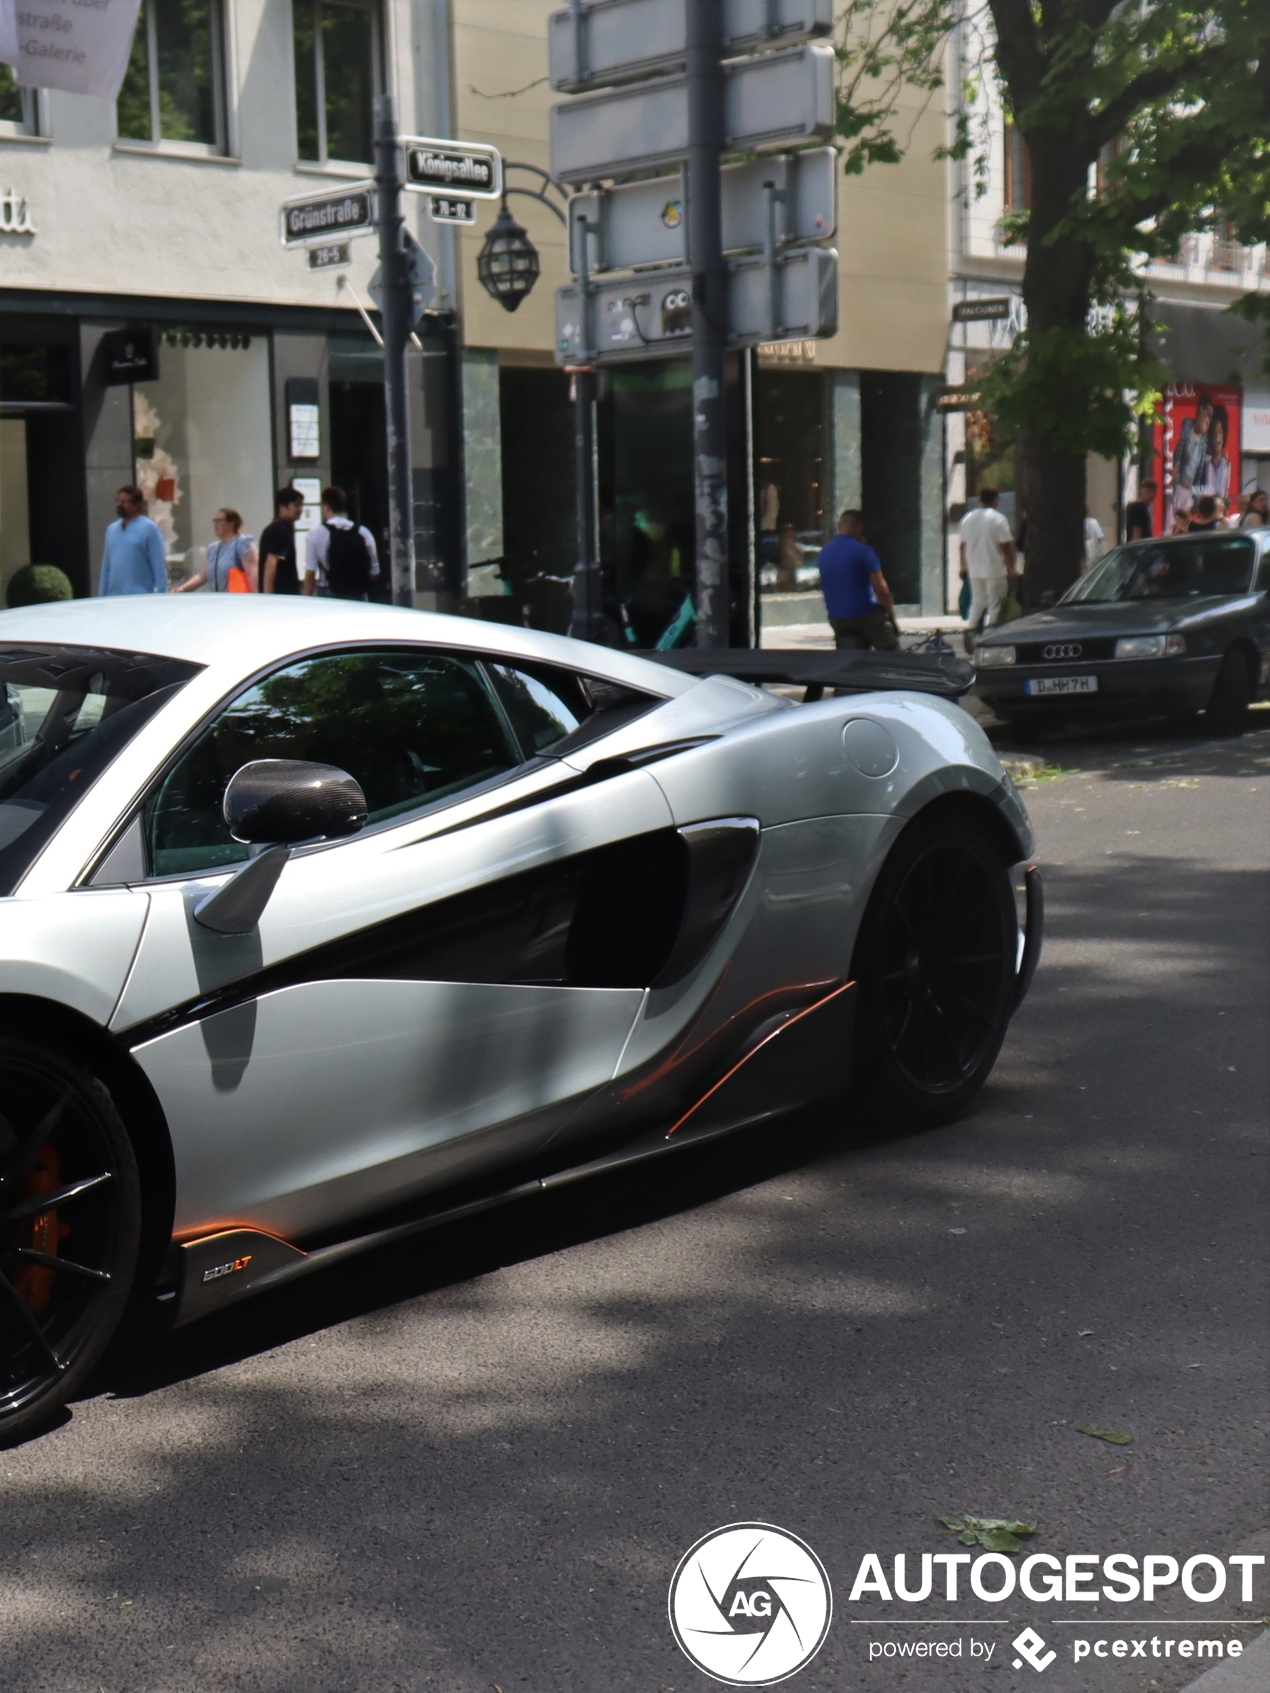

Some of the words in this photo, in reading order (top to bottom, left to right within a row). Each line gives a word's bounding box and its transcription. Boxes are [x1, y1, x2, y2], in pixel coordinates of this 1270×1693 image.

[417, 151, 489, 182] Königsallee
[290, 199, 360, 232] Grünstraße
[203, 1255, 252, 1282] 600LT
